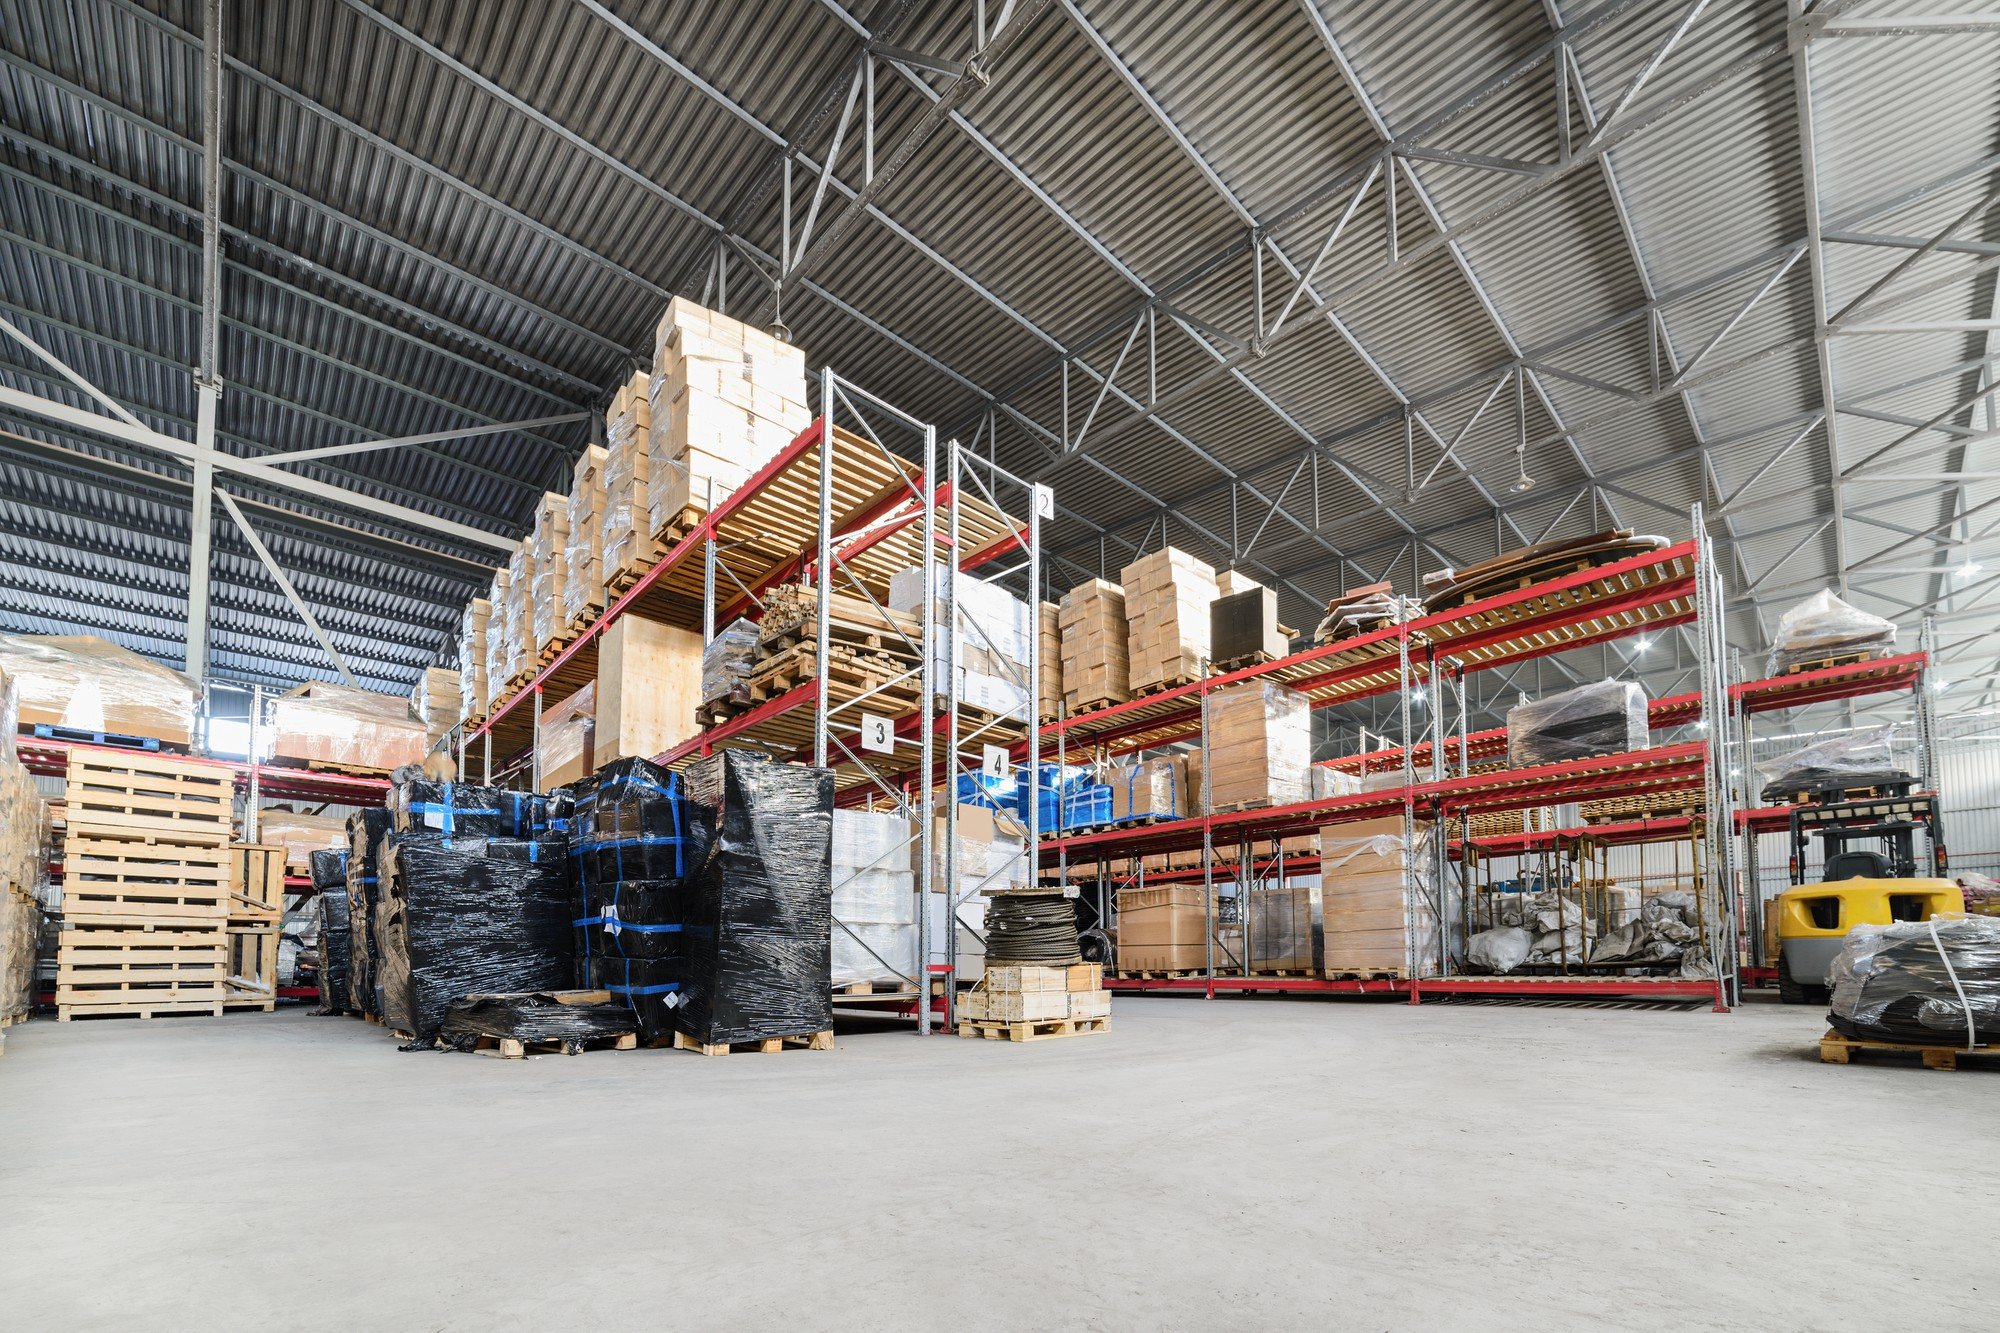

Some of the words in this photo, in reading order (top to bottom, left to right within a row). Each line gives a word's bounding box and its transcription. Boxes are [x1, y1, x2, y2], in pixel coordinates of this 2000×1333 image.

[1039, 493, 1049, 515] 2
[876, 722, 885, 744] 3
[994, 754, 1002, 775] 4
